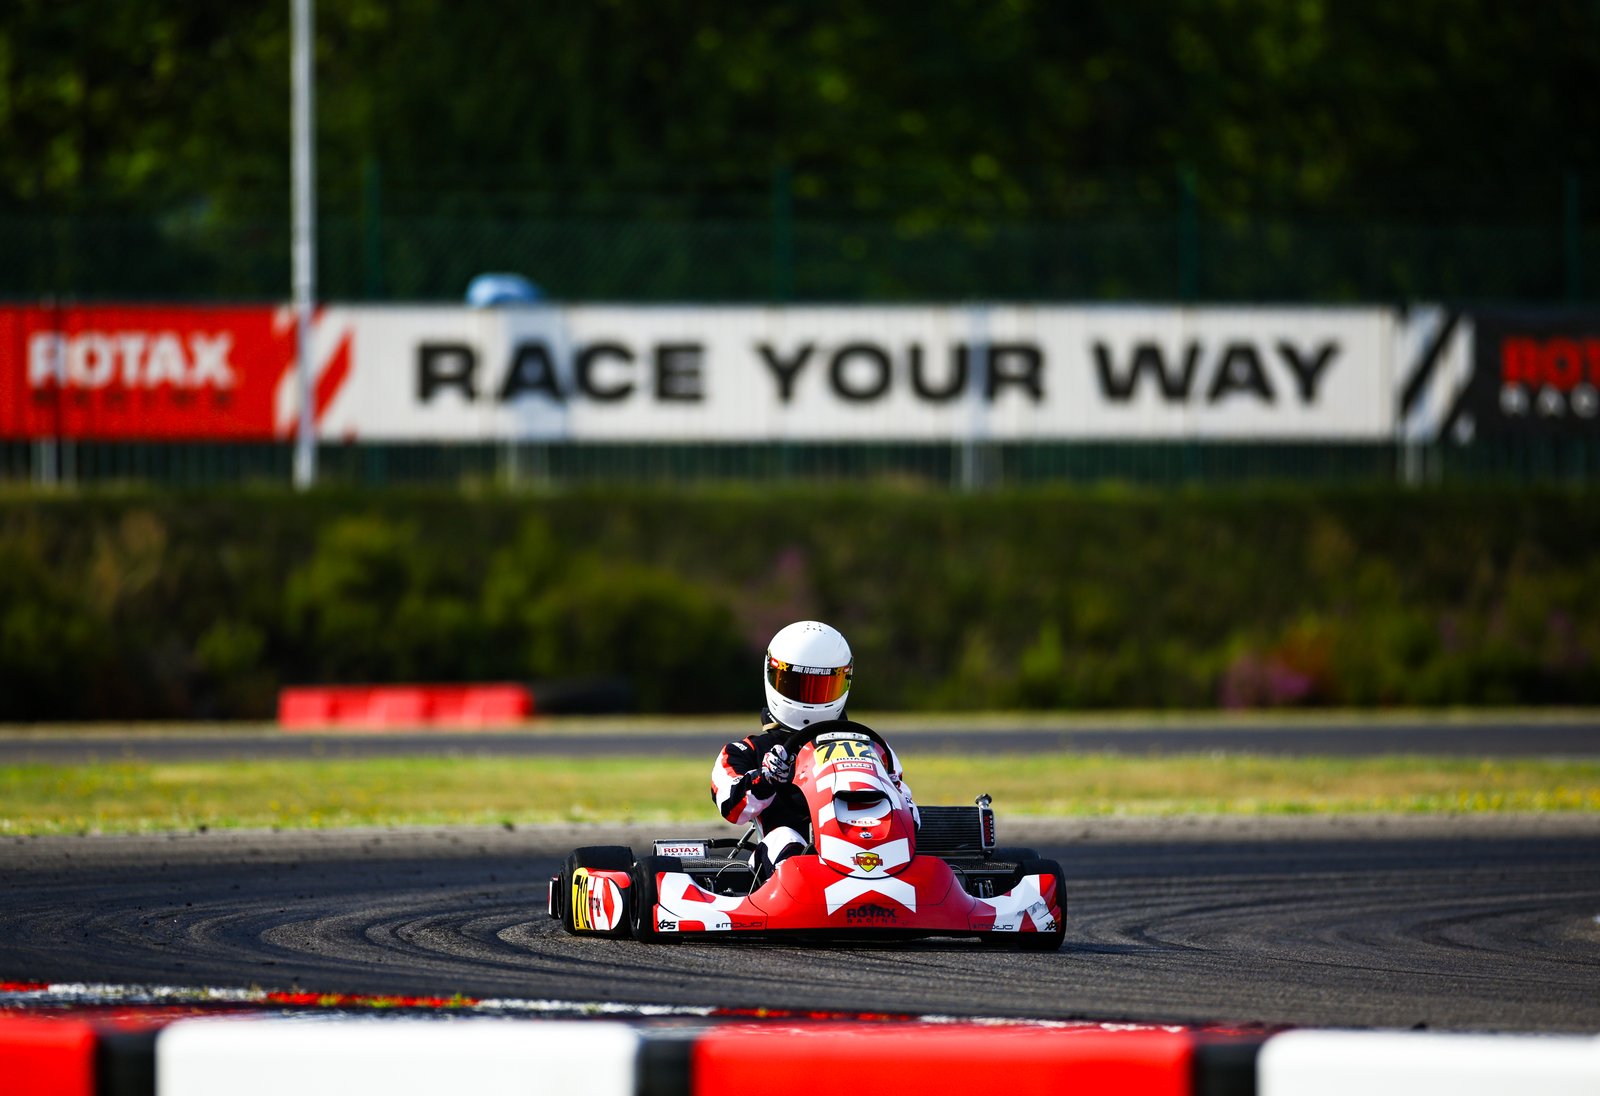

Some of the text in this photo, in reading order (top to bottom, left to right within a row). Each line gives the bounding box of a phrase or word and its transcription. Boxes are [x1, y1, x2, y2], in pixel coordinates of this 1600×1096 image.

[28, 332, 234, 388] ROTAX
[415, 341, 1340, 403] RACE YOUR WAY
[817, 741, 879, 764] 712
[846, 907, 897, 918] ROTAX
[657, 919, 677, 930] XPS
